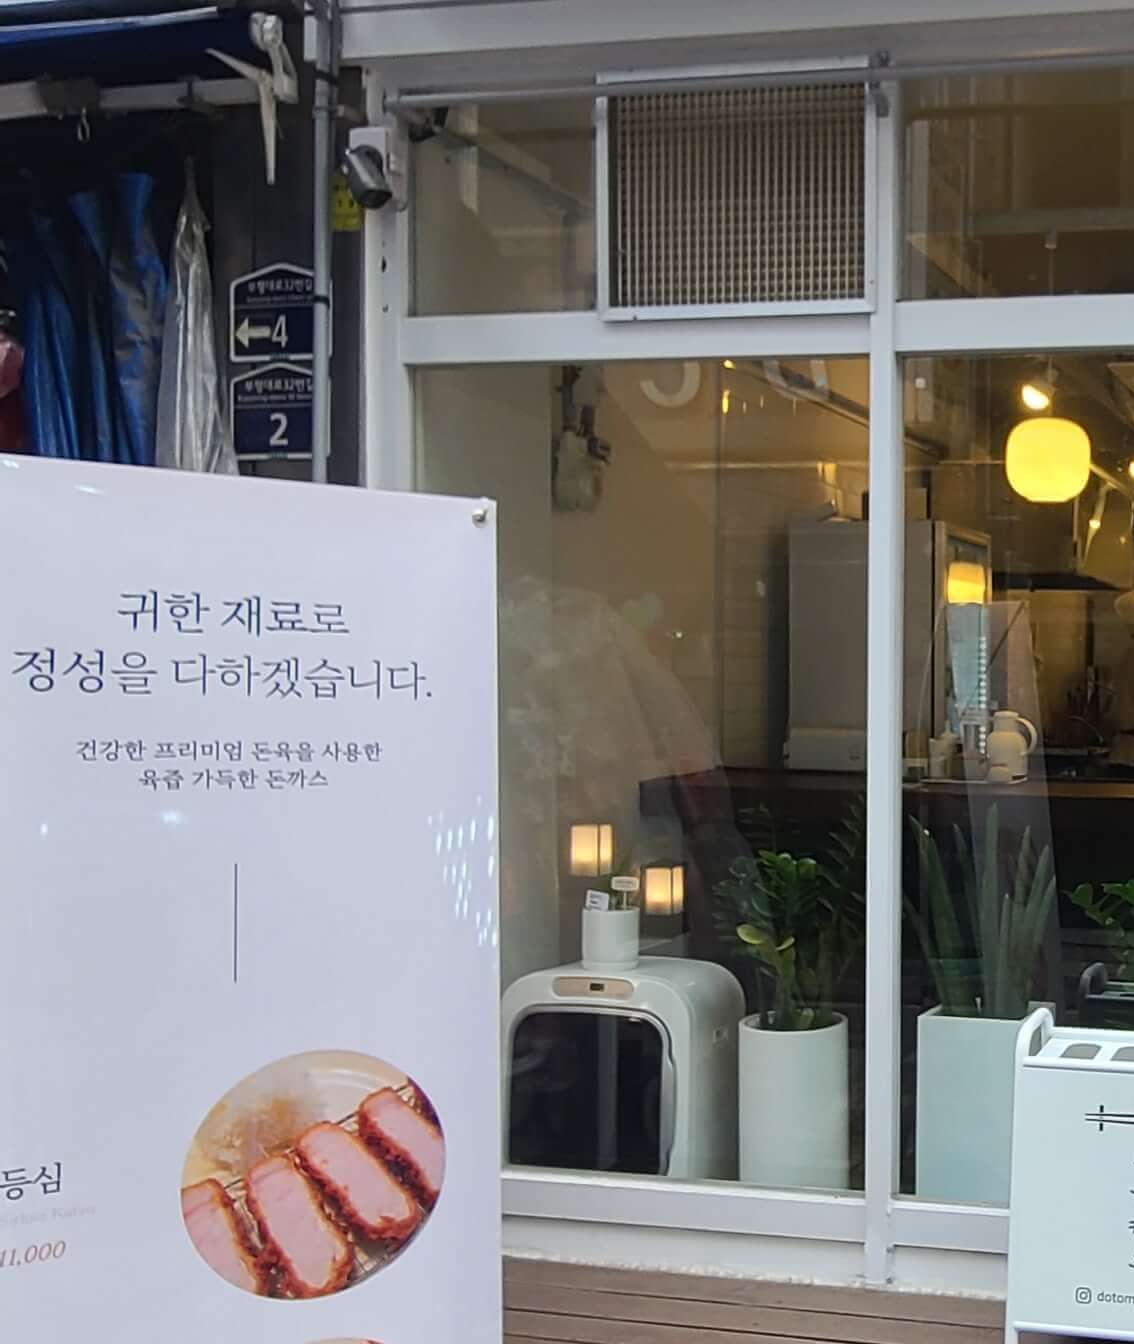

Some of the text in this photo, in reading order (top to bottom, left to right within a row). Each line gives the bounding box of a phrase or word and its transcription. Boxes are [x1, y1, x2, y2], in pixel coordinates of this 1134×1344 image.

[271, 314, 289, 348] 4
[269, 412, 289, 446] 2
[117, 589, 350, 637] 귀한 재료로
[12, 647, 433, 701] 정성을 다하겠습니다.
[76, 739, 383, 764] 건강한 프리미엄 돈육을 사용한
[139, 768, 329, 792] 육즙 가득한 돈까스
[0, 1161, 62, 1201] 등심
